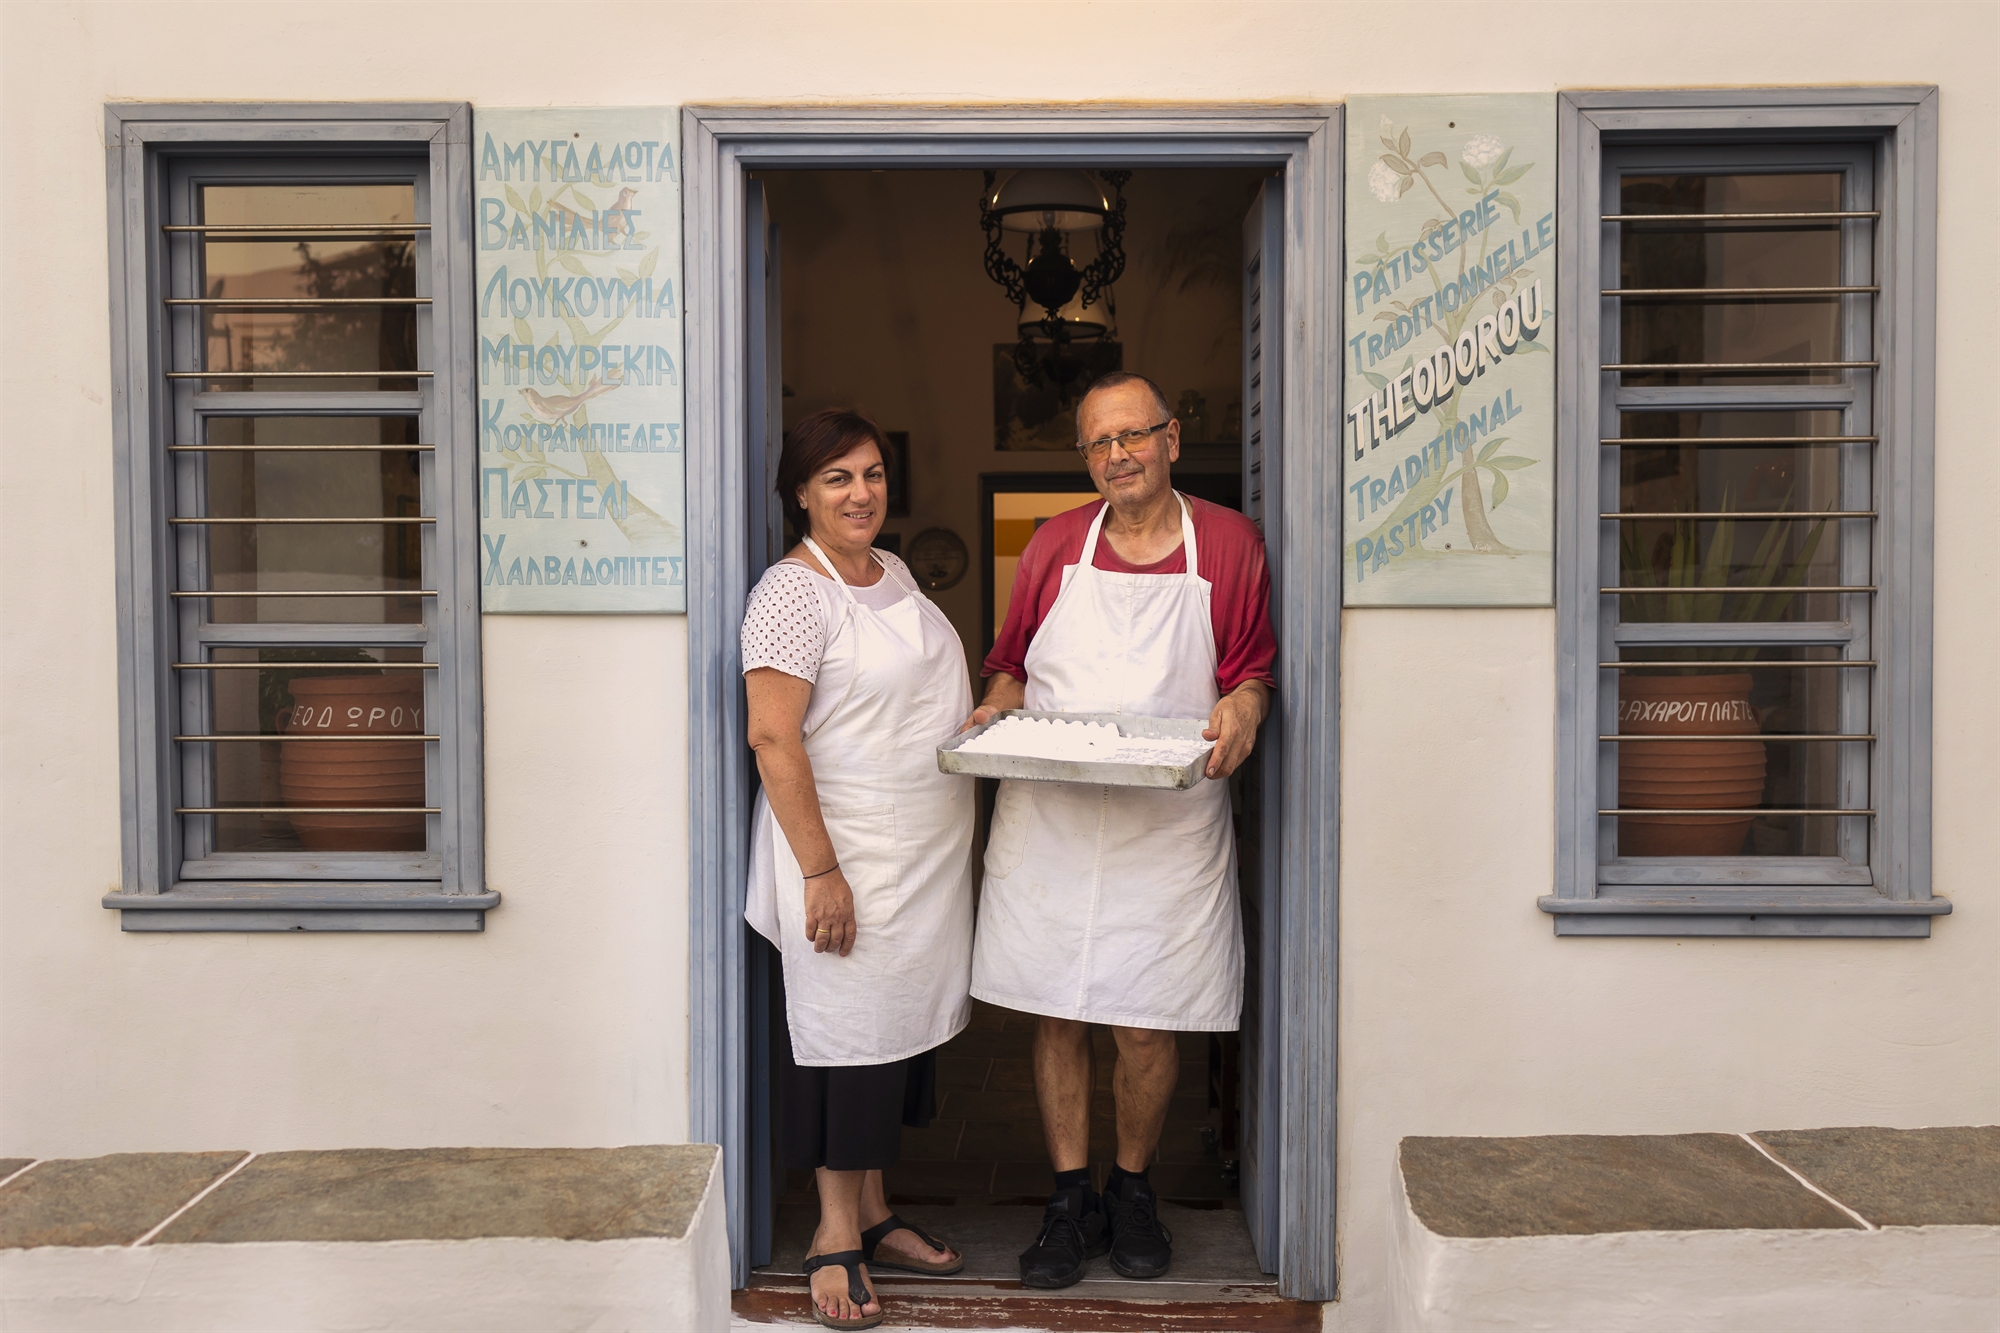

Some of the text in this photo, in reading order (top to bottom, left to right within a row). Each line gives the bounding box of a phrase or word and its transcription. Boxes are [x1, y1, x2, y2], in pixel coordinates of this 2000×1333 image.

[479, 131, 677, 182] ΑΜΥΓΔΑΛΩΤΑ
[480, 198, 643, 251] ΒΑΝΙΛΙΕΣ
[1353, 189, 1500, 315] PÂTISSERIE
[481, 265, 676, 319] ΛΟΥΚΟΥΜΙΑ
[1349, 211, 1554, 375] TRADITIONNELLE
[481, 333, 678, 386] ΜΠΟΥΡΕΚΙΑ
[1348, 278, 1543, 461] THEODOROU
[481, 399, 681, 453] ΚΟΥΡΑΜΠΙΕΔΕΣ
[1350, 388, 1522, 522] TRADITIONAL
[483, 468, 628, 520] ΠΑΣΤΕΛΙ
[482, 534, 683, 586] ΧΑΛΒΑΔΟΠΙΤΕΣ
[1355, 487, 1454, 583] PASTRY
[290, 704, 421, 729] ΕΟΔΩΡΟΥ
